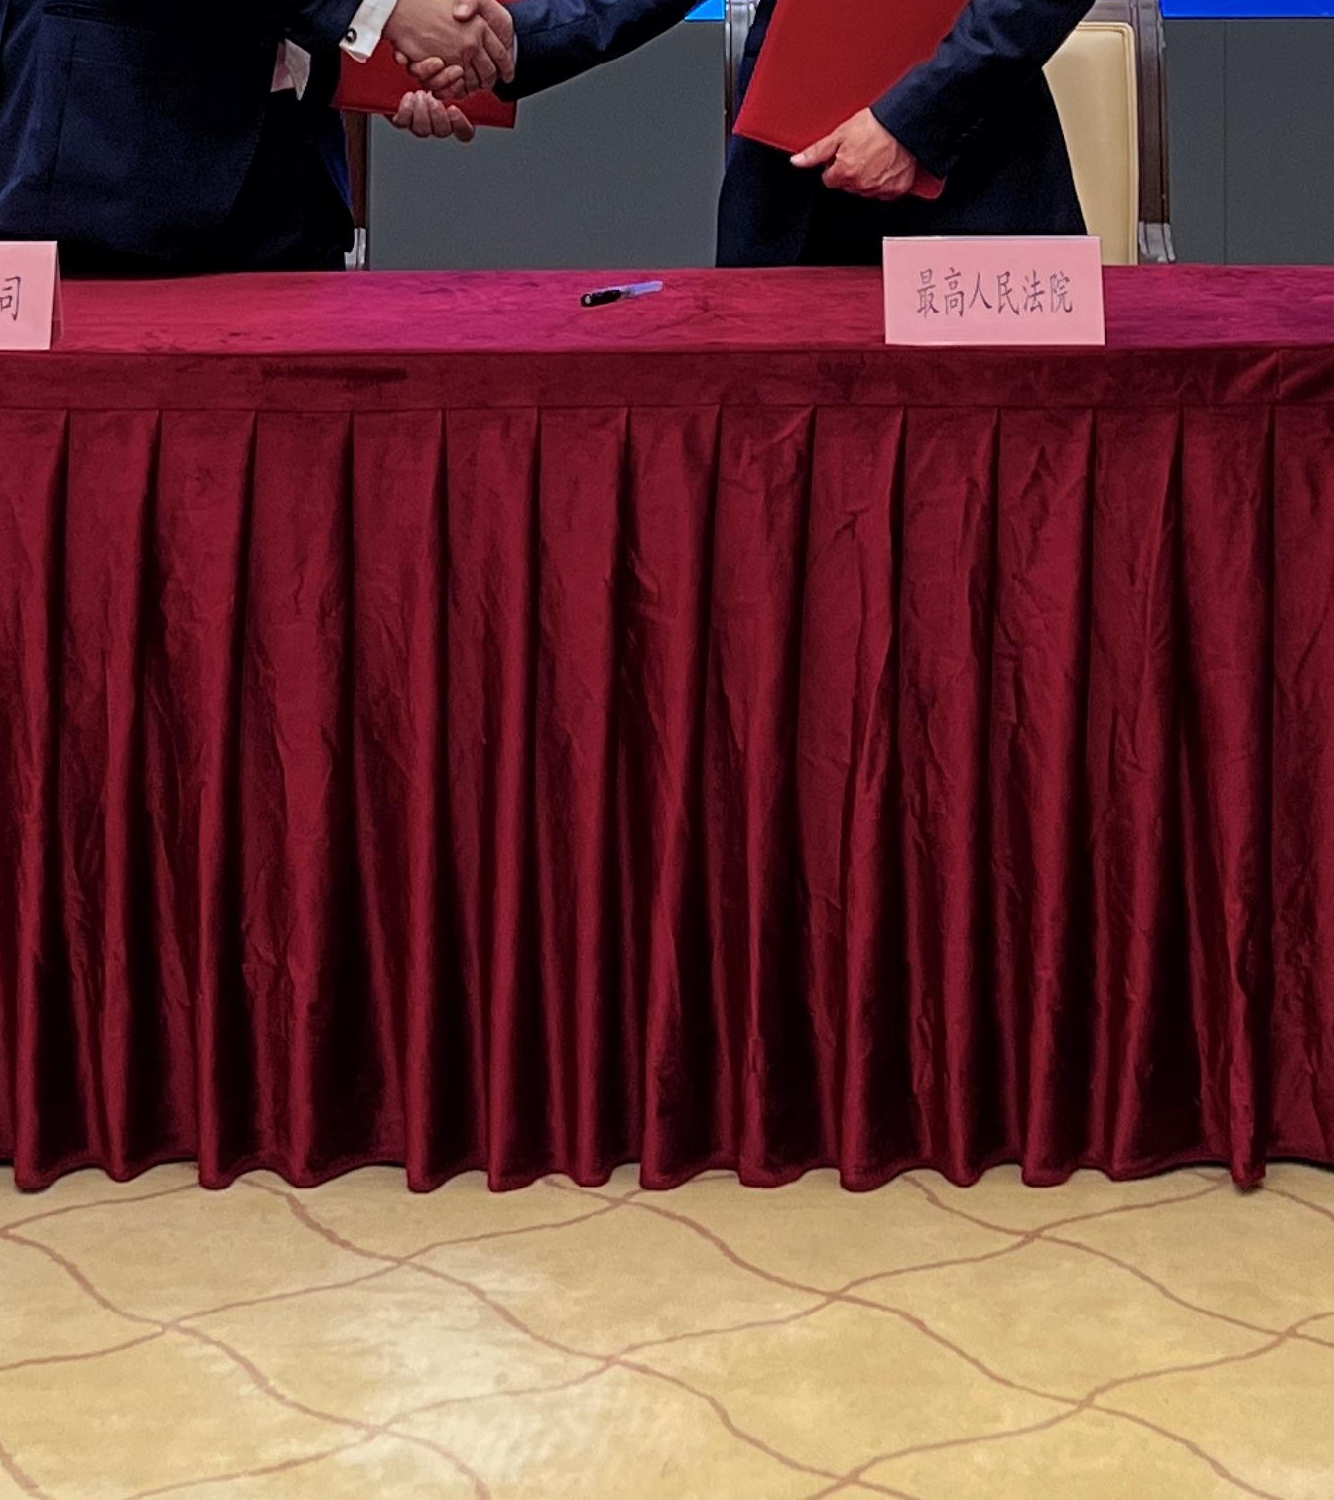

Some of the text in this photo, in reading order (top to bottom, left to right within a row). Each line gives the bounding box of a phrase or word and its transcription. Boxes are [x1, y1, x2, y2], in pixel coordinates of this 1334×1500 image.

[915, 267, 1074, 317] 最高人民法院
